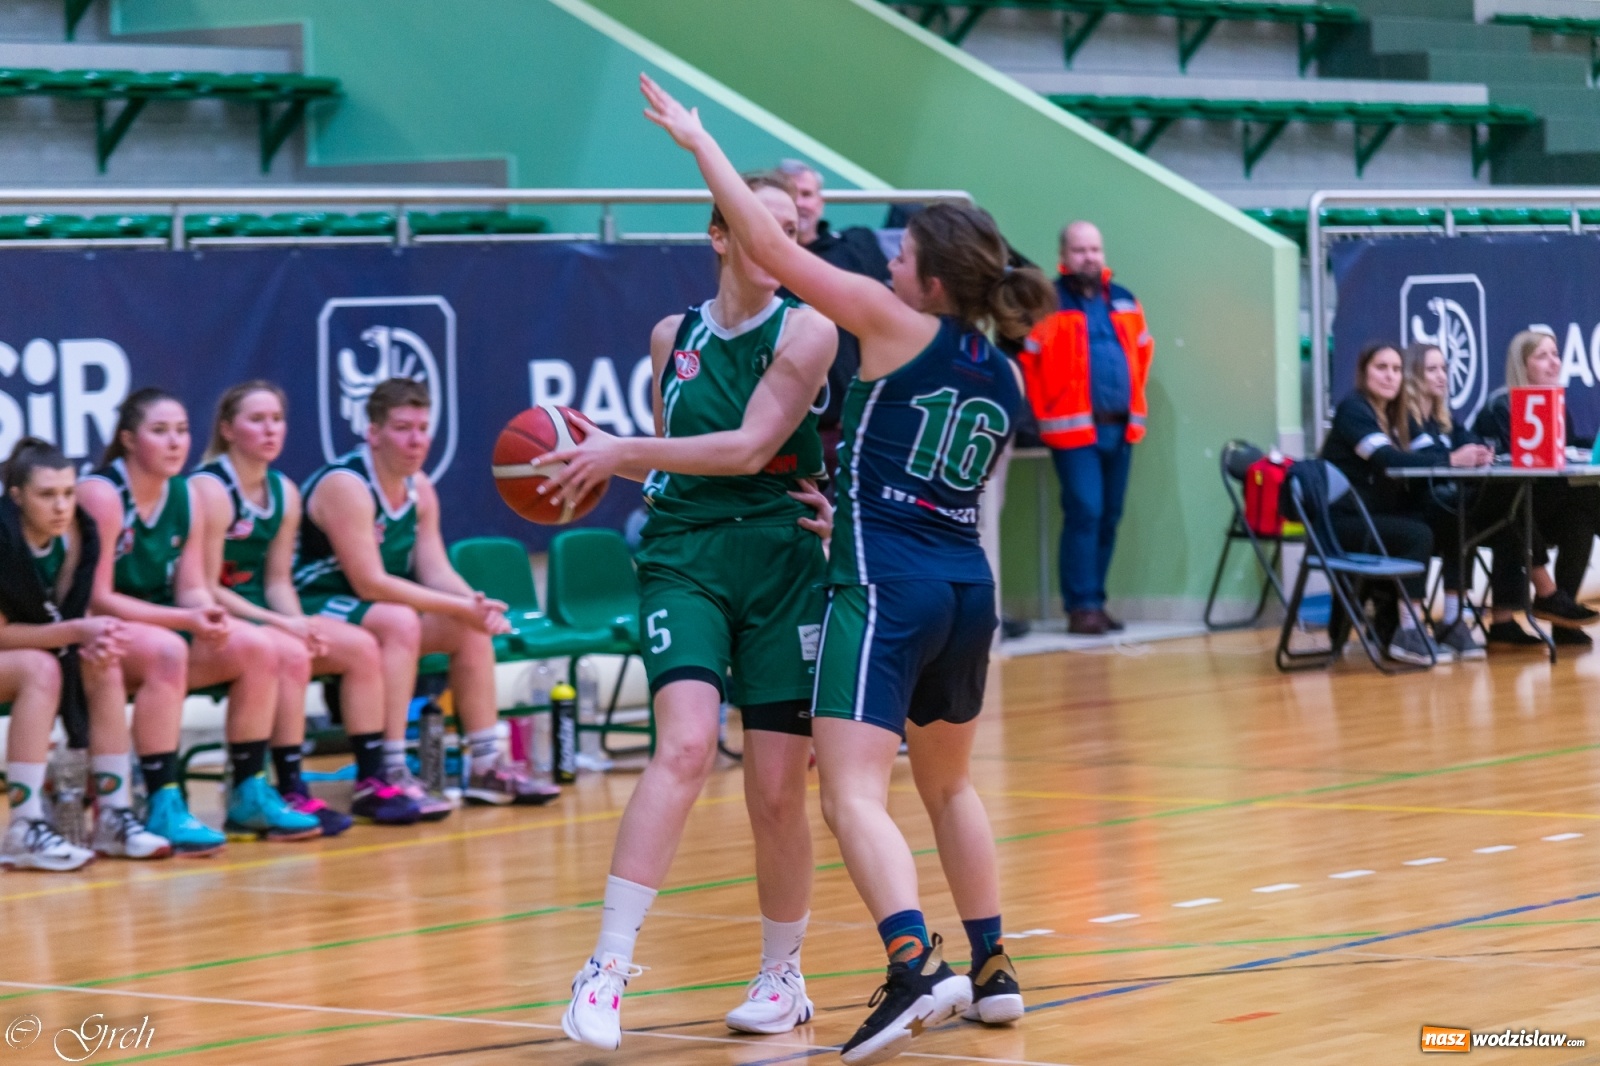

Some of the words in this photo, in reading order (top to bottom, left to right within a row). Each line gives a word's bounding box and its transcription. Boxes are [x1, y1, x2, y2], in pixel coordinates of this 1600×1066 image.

[906, 386, 1010, 491] 16
[1516, 394, 1546, 450] 5
[647, 608, 673, 654] 5
